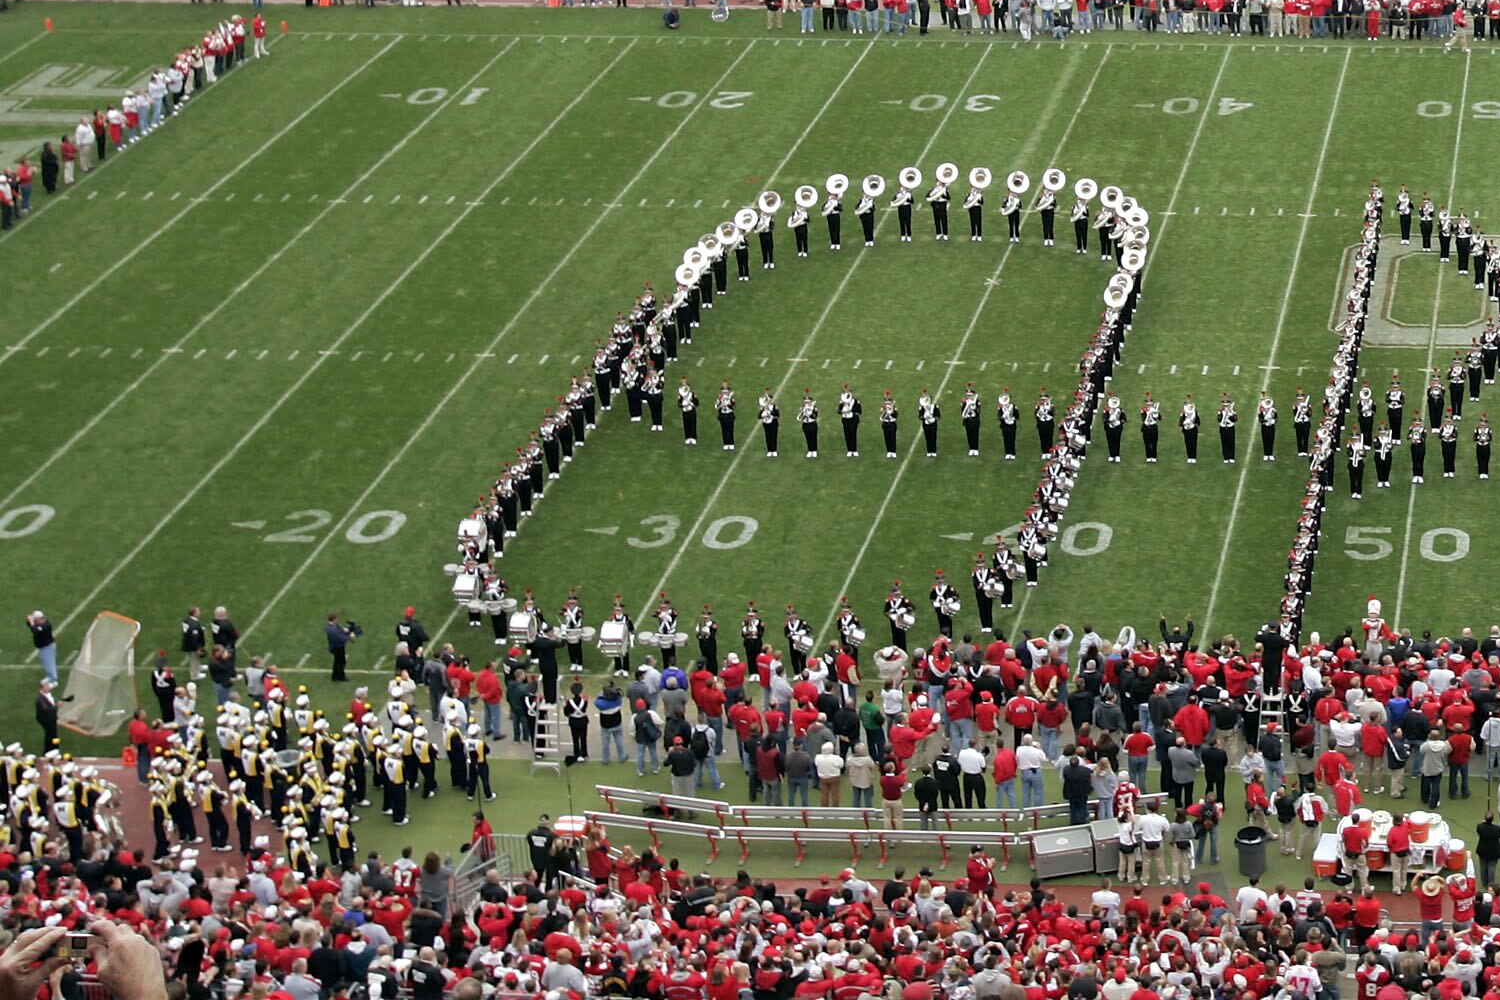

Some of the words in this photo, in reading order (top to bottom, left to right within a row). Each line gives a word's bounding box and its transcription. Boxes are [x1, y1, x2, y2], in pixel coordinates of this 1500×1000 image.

[263, 509, 408, 545] 20
[626, 514, 760, 551] 30
[1343, 526, 1471, 563] 50
[1365, 982, 1377, 998] 8
